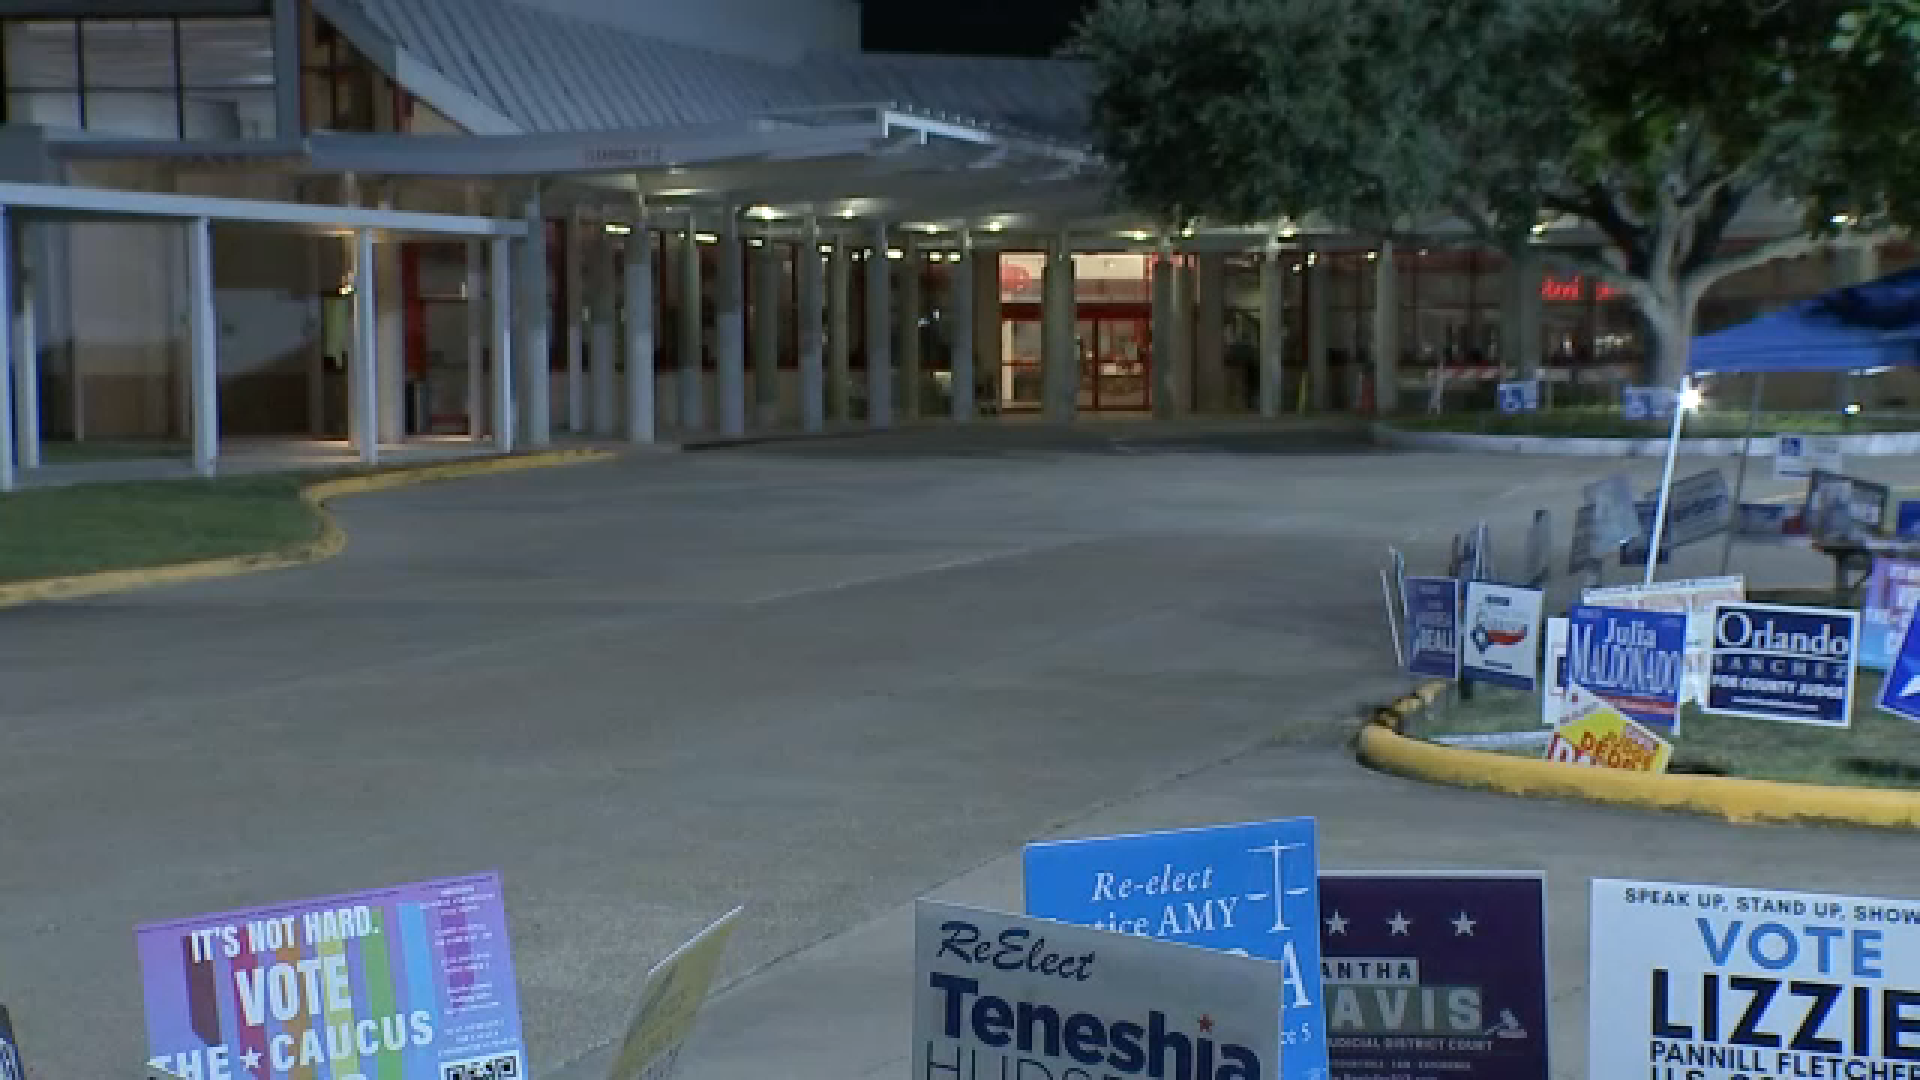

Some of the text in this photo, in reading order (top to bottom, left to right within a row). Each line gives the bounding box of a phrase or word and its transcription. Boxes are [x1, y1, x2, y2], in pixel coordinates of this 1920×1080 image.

[1604, 617, 1657, 648] Julia
[1718, 611, 1849, 655] Orlando
[1741, 677, 1796, 694] COUNTY
[1797, 683, 1844, 700] JUDGE
[1091, 863, 1214, 901] Re-elect
[1624, 887, 1690, 906] SPEAK
[1736, 896, 1806, 915] STAND
[191, 905, 379, 963] IT'S NOT HARD.
[1157, 896, 1239, 937] AMY
[936, 920, 1096, 982] ReElect
[1695, 917, 1883, 978] VOTE
[234, 954, 351, 1026] VOTE
[1652, 968, 1920, 1059] LIZZIE
[269, 1010, 432, 1070] CAUCUS
[930, 971, 1261, 1080] Teneshia
[1650, 1040, 1767, 1073] PANNILL
